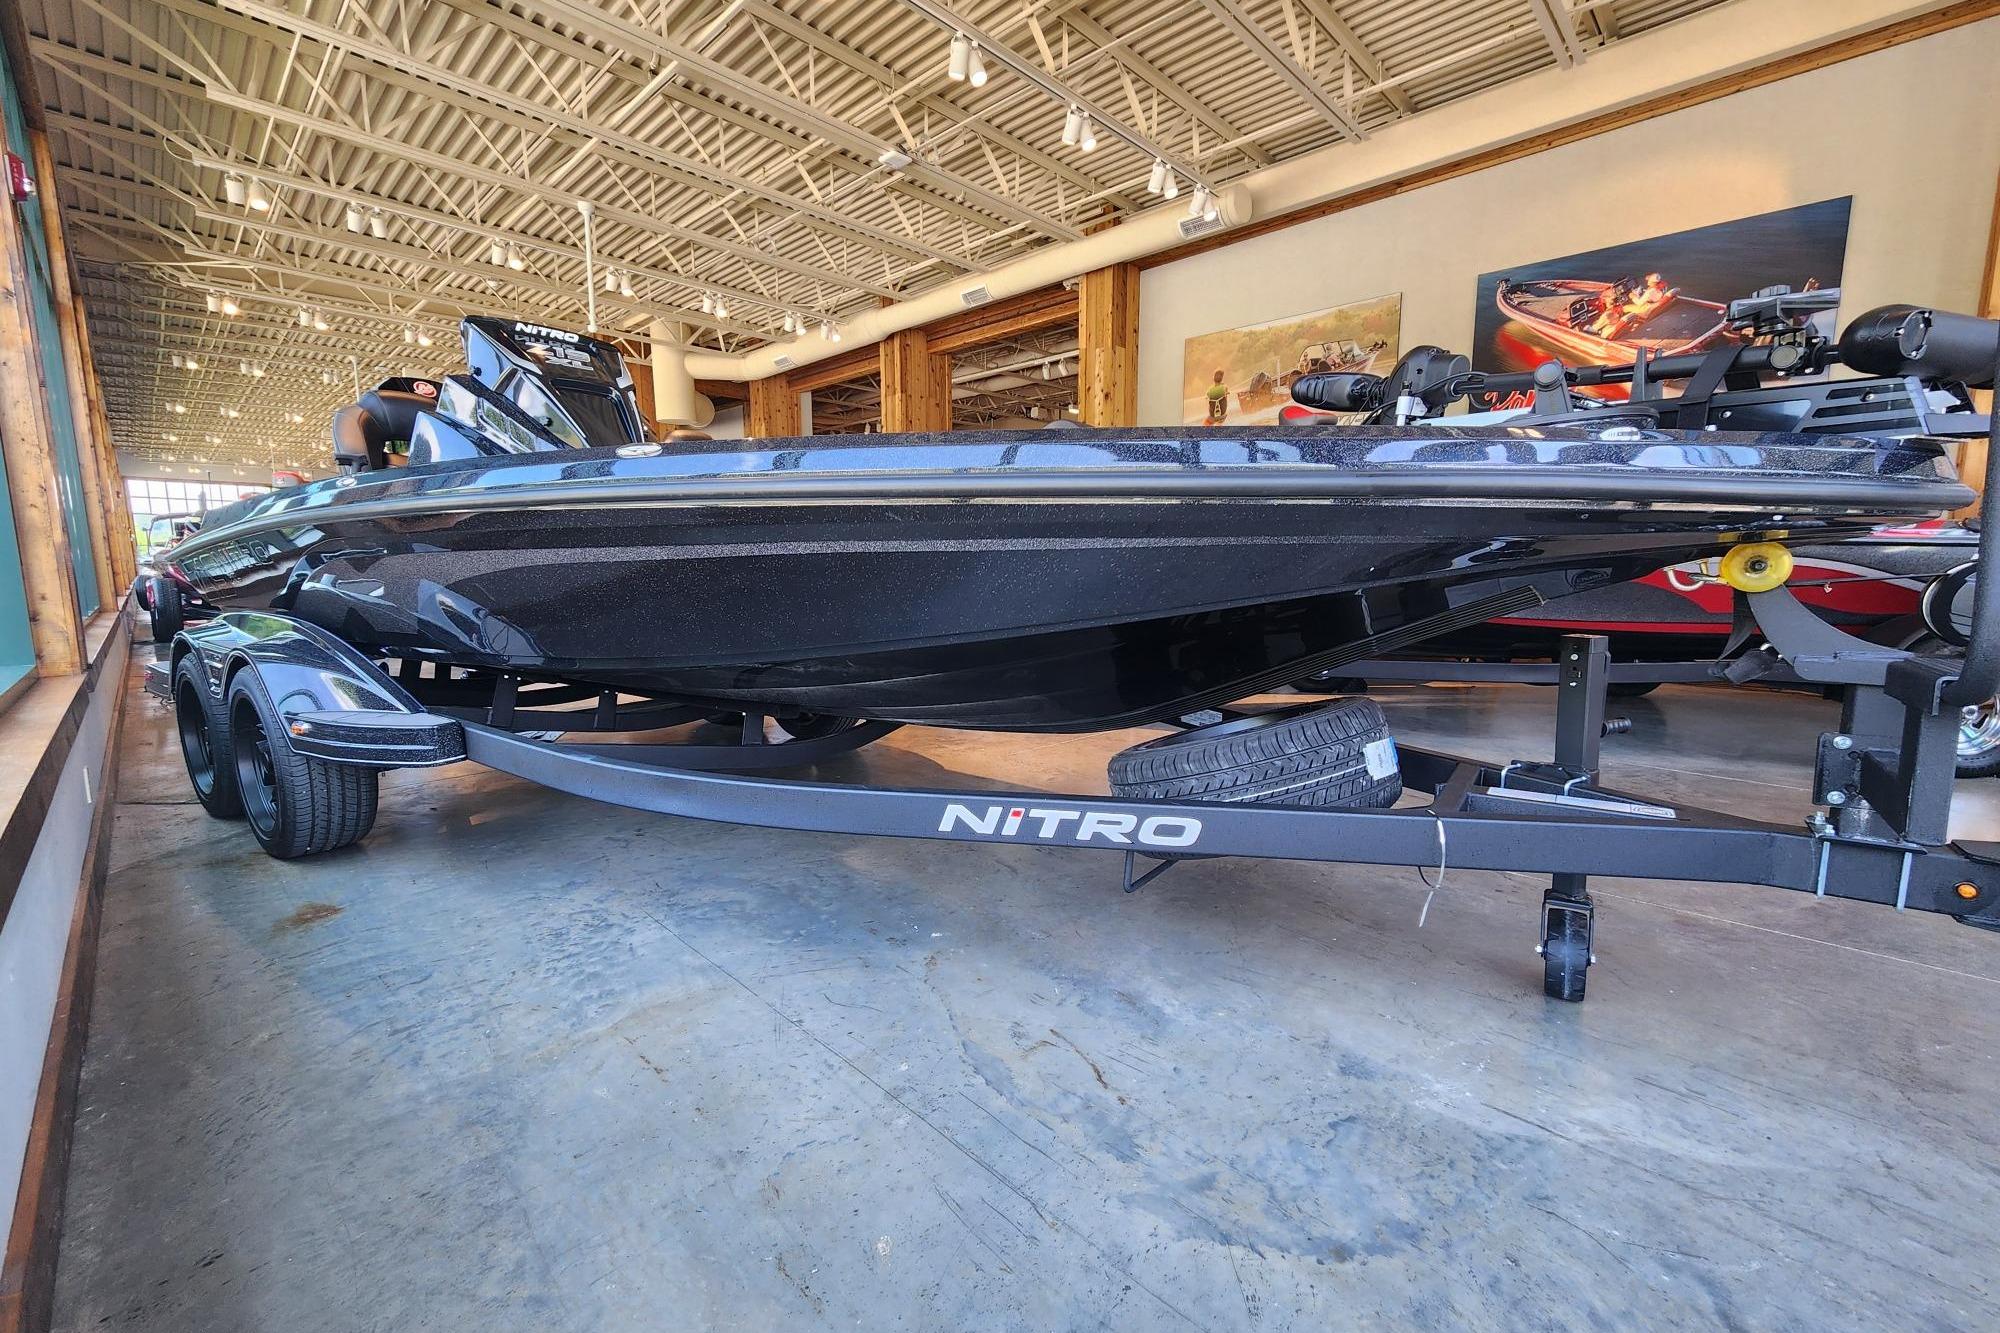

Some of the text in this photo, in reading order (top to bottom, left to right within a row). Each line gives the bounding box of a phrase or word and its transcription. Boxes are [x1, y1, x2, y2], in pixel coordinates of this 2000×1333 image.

[514, 322, 580, 343] NITRO
[545, 355, 594, 370] XL
[938, 804, 1203, 847] NITRO
